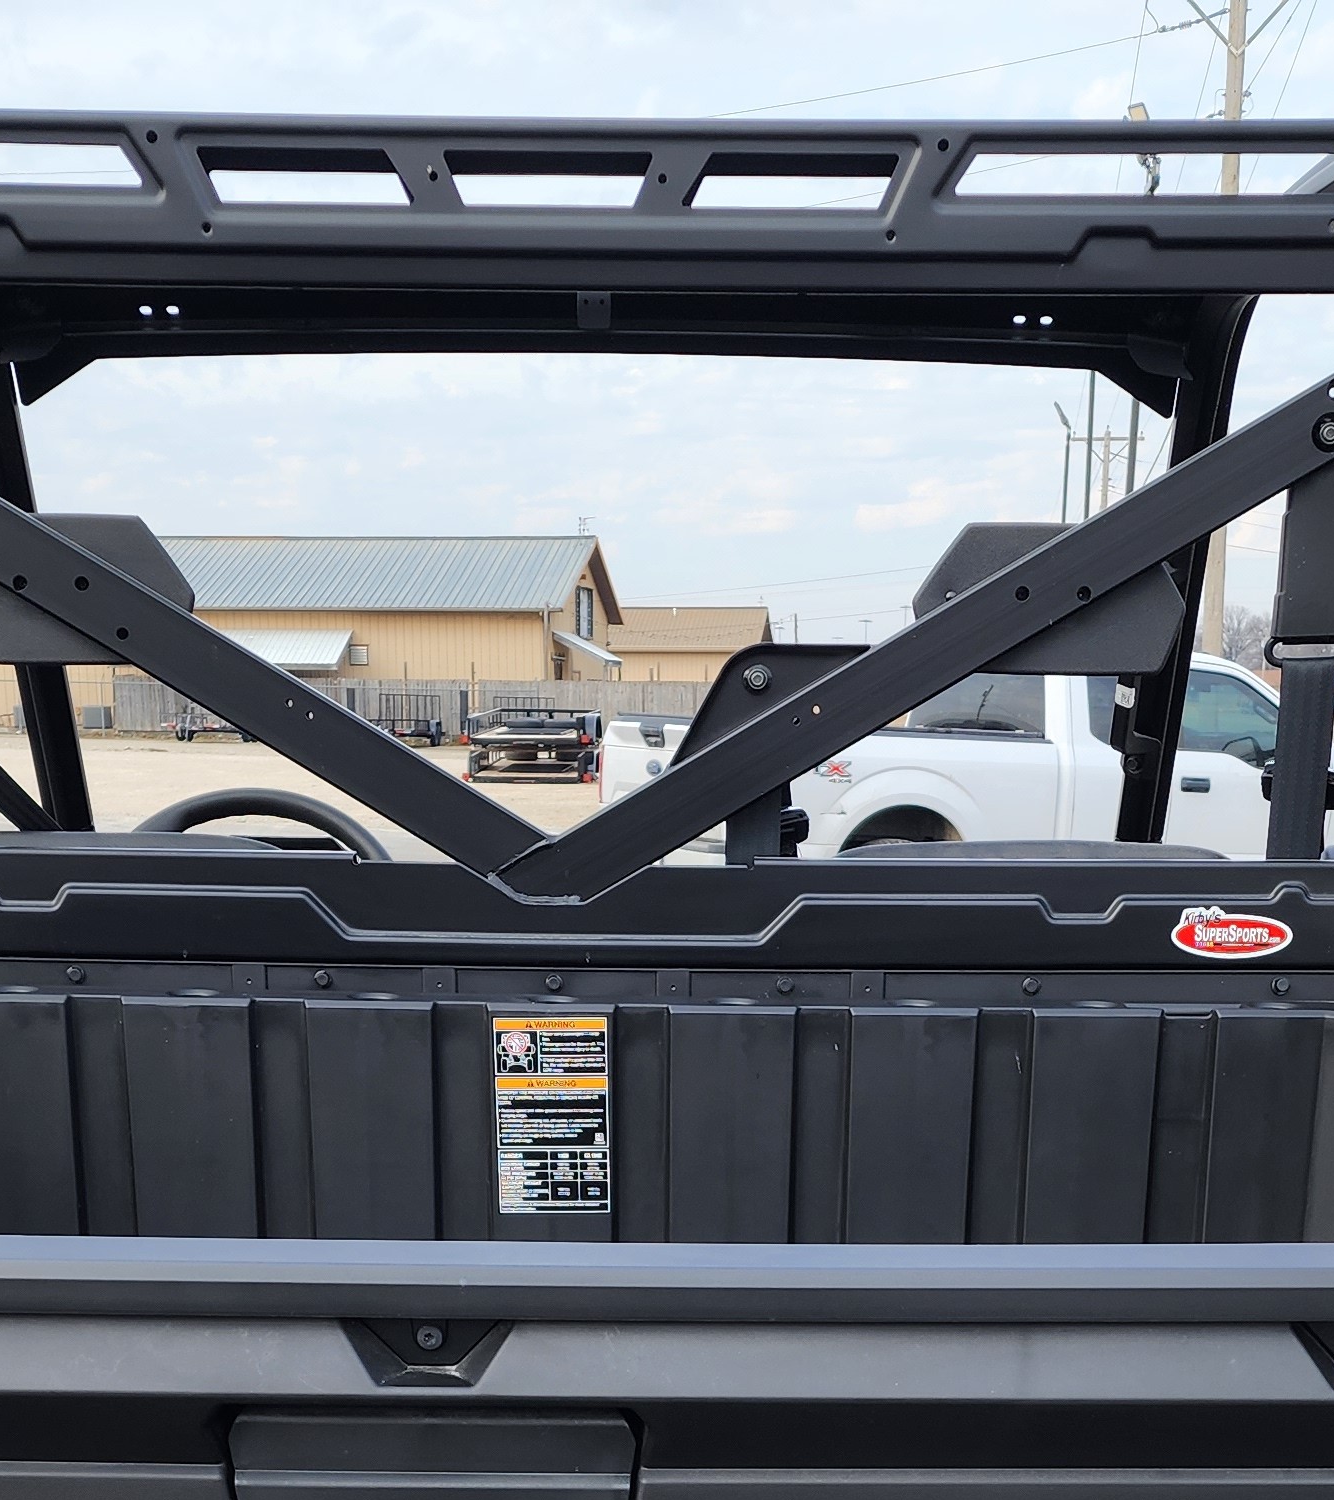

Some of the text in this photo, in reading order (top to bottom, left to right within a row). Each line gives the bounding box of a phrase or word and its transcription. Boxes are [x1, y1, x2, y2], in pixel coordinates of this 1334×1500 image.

[1183, 911, 1222, 927] Kirby's
[534, 1021, 576, 1029] WARNING
[536, 1079, 577, 1088] WARNING
